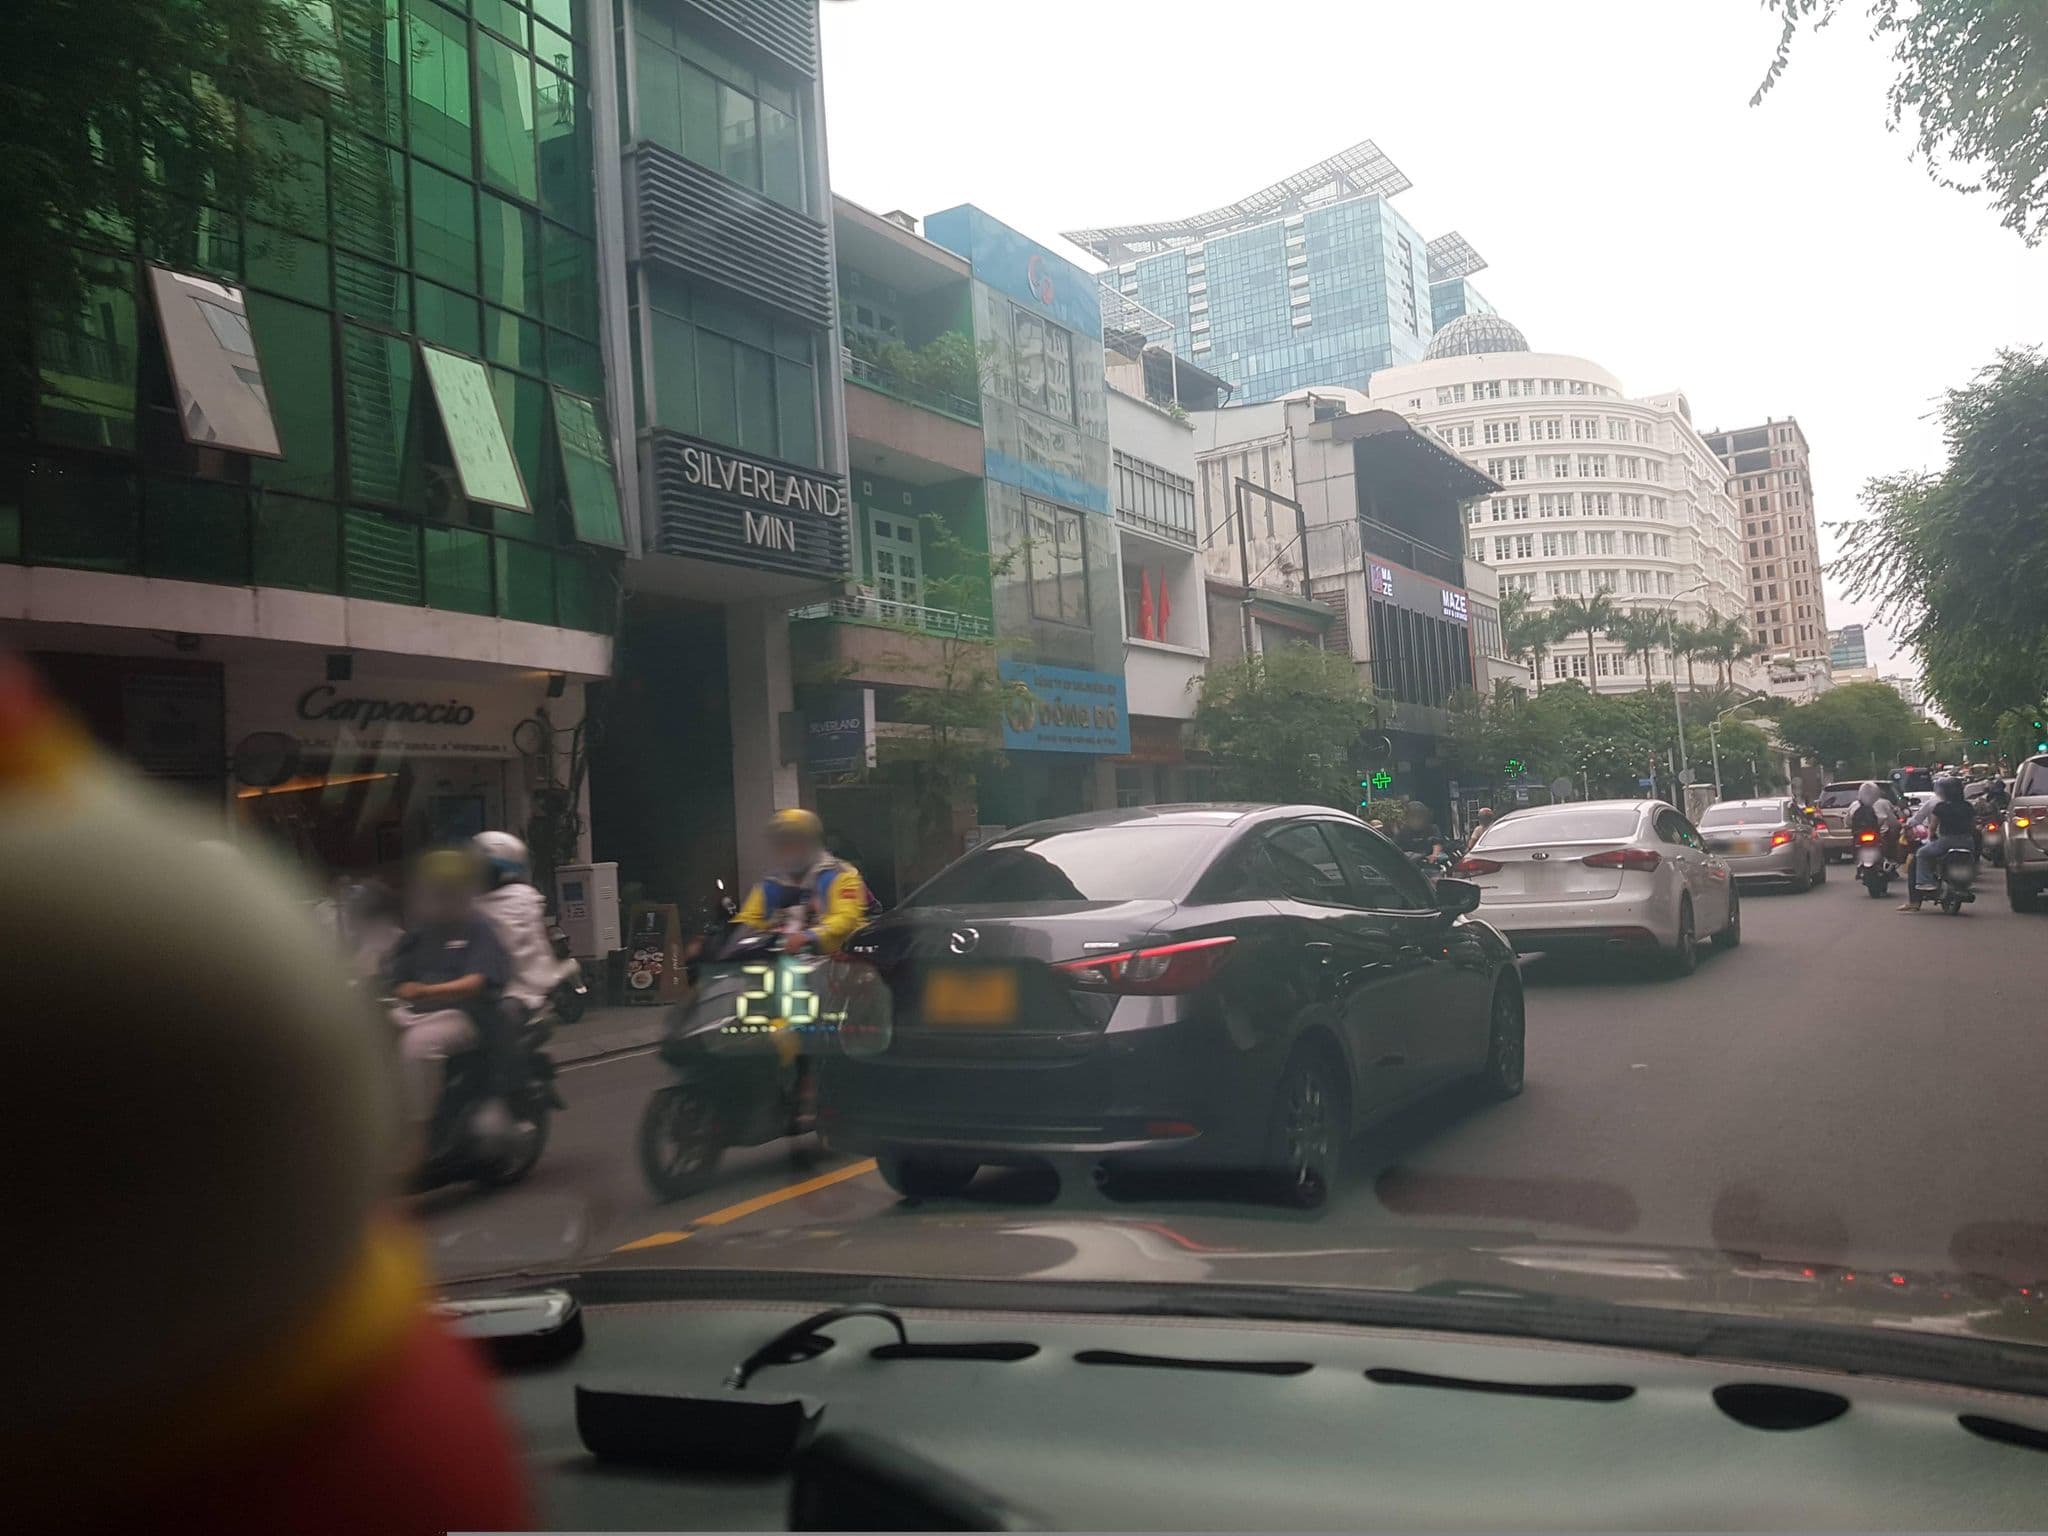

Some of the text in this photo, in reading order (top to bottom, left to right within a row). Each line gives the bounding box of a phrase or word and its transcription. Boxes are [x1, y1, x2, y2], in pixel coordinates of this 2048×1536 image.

[682, 448, 841, 517] SILVERLAND
[744, 511, 796, 552] MIN
[1382, 582, 1394, 597] ZE
[1442, 589, 1468, 613] MAZE
[296, 686, 475, 731] Carpaccio
[736, 964, 819, 1024] 26
